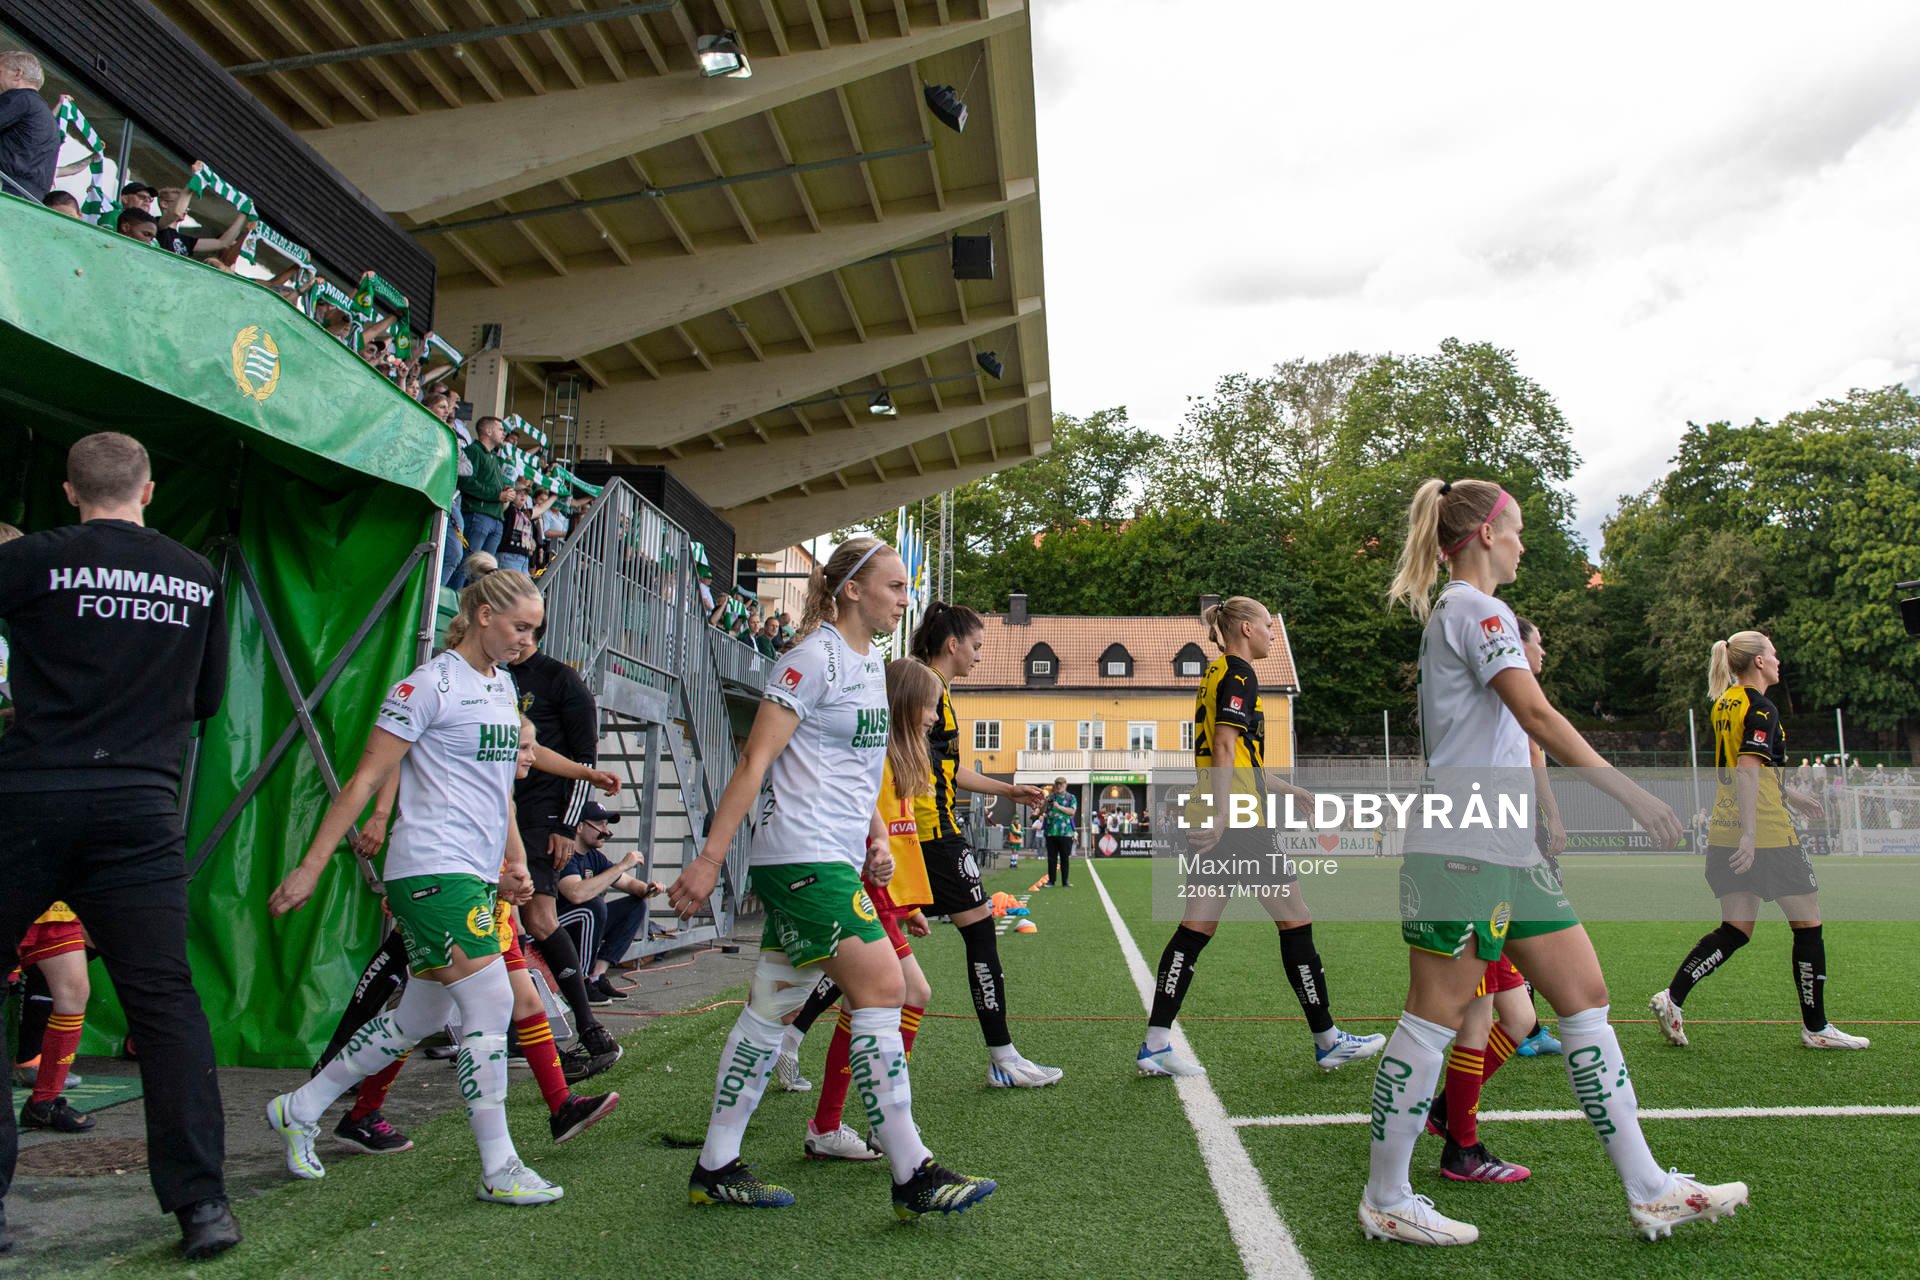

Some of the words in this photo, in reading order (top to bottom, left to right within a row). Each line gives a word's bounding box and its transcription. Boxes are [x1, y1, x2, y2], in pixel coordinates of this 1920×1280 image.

[50, 567, 214, 607] HAMMARBY
[77, 595, 190, 628] FOTBOLL
[891, 822, 917, 834] KVA
[1340, 837, 1375, 850] BAJE
[1563, 834, 1625, 848] RÖNSAKS
[970, 884, 983, 902] 17
[1809, 873, 1816, 887] 6
[355, 950, 391, 1001] MAXXIS
[1164, 950, 1185, 997] MAXXIS
[1297, 964, 1320, 1005] MAXXIS
[1691, 948, 1724, 982] MAXXIS
[1798, 960, 1815, 1007] MAXXIS
[973, 961, 999, 1011] MAXXIS
[850, 1034, 885, 1126] Clinton
[1371, 1055, 1413, 1142] Clinton
[1568, 1045, 1617, 1137] Clinton
